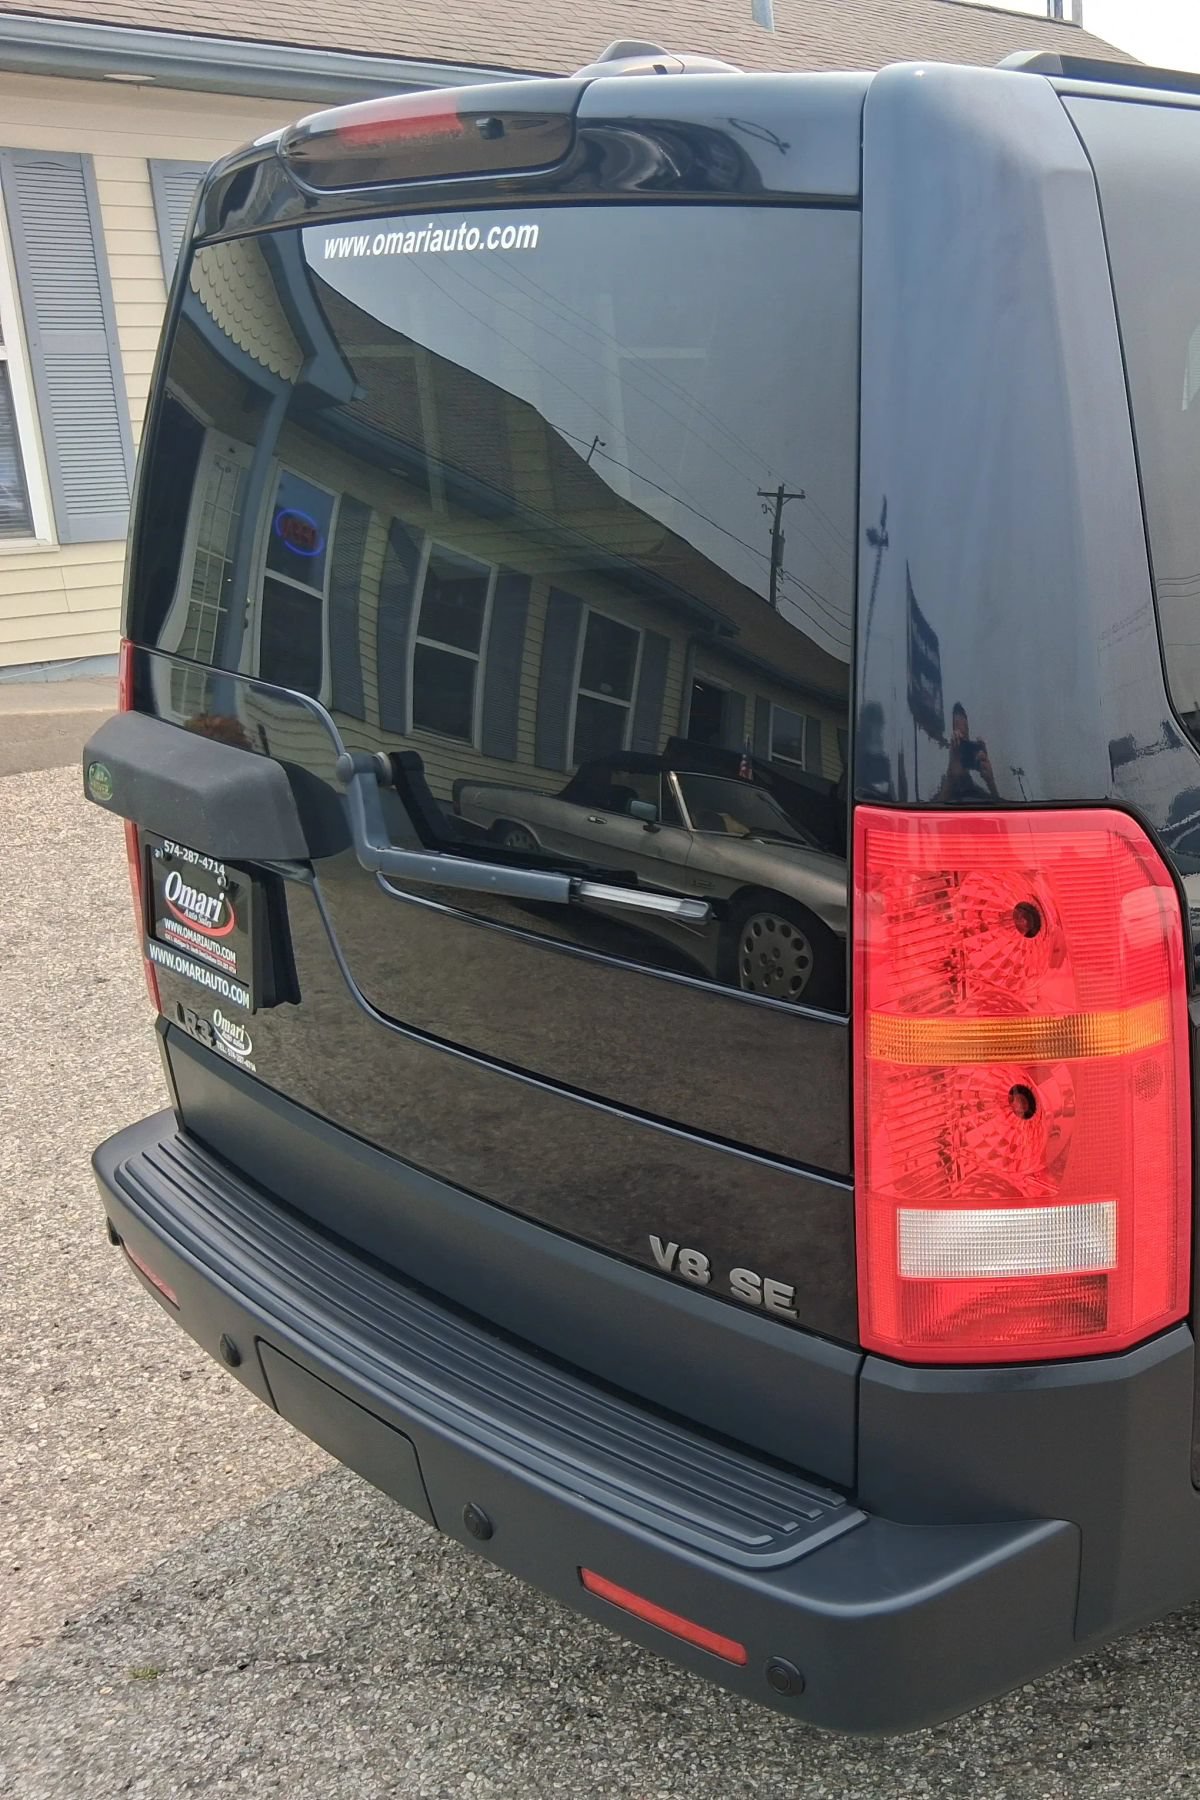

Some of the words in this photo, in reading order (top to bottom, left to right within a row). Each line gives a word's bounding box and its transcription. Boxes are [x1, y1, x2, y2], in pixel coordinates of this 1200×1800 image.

[324, 221, 540, 260] www.omariauto.com
[163, 840, 225, 875] 574-287-4714
[165, 871, 225, 922] Omari
[164, 917, 236, 963] WWW.OMARIAUTO.COM
[149, 943, 250, 1008] WWW.OMARIAUTO.COM
[213, 1009, 245, 1042] Omari
[649, 1235, 712, 1286] V8
[729, 1268, 798, 1320] SE
